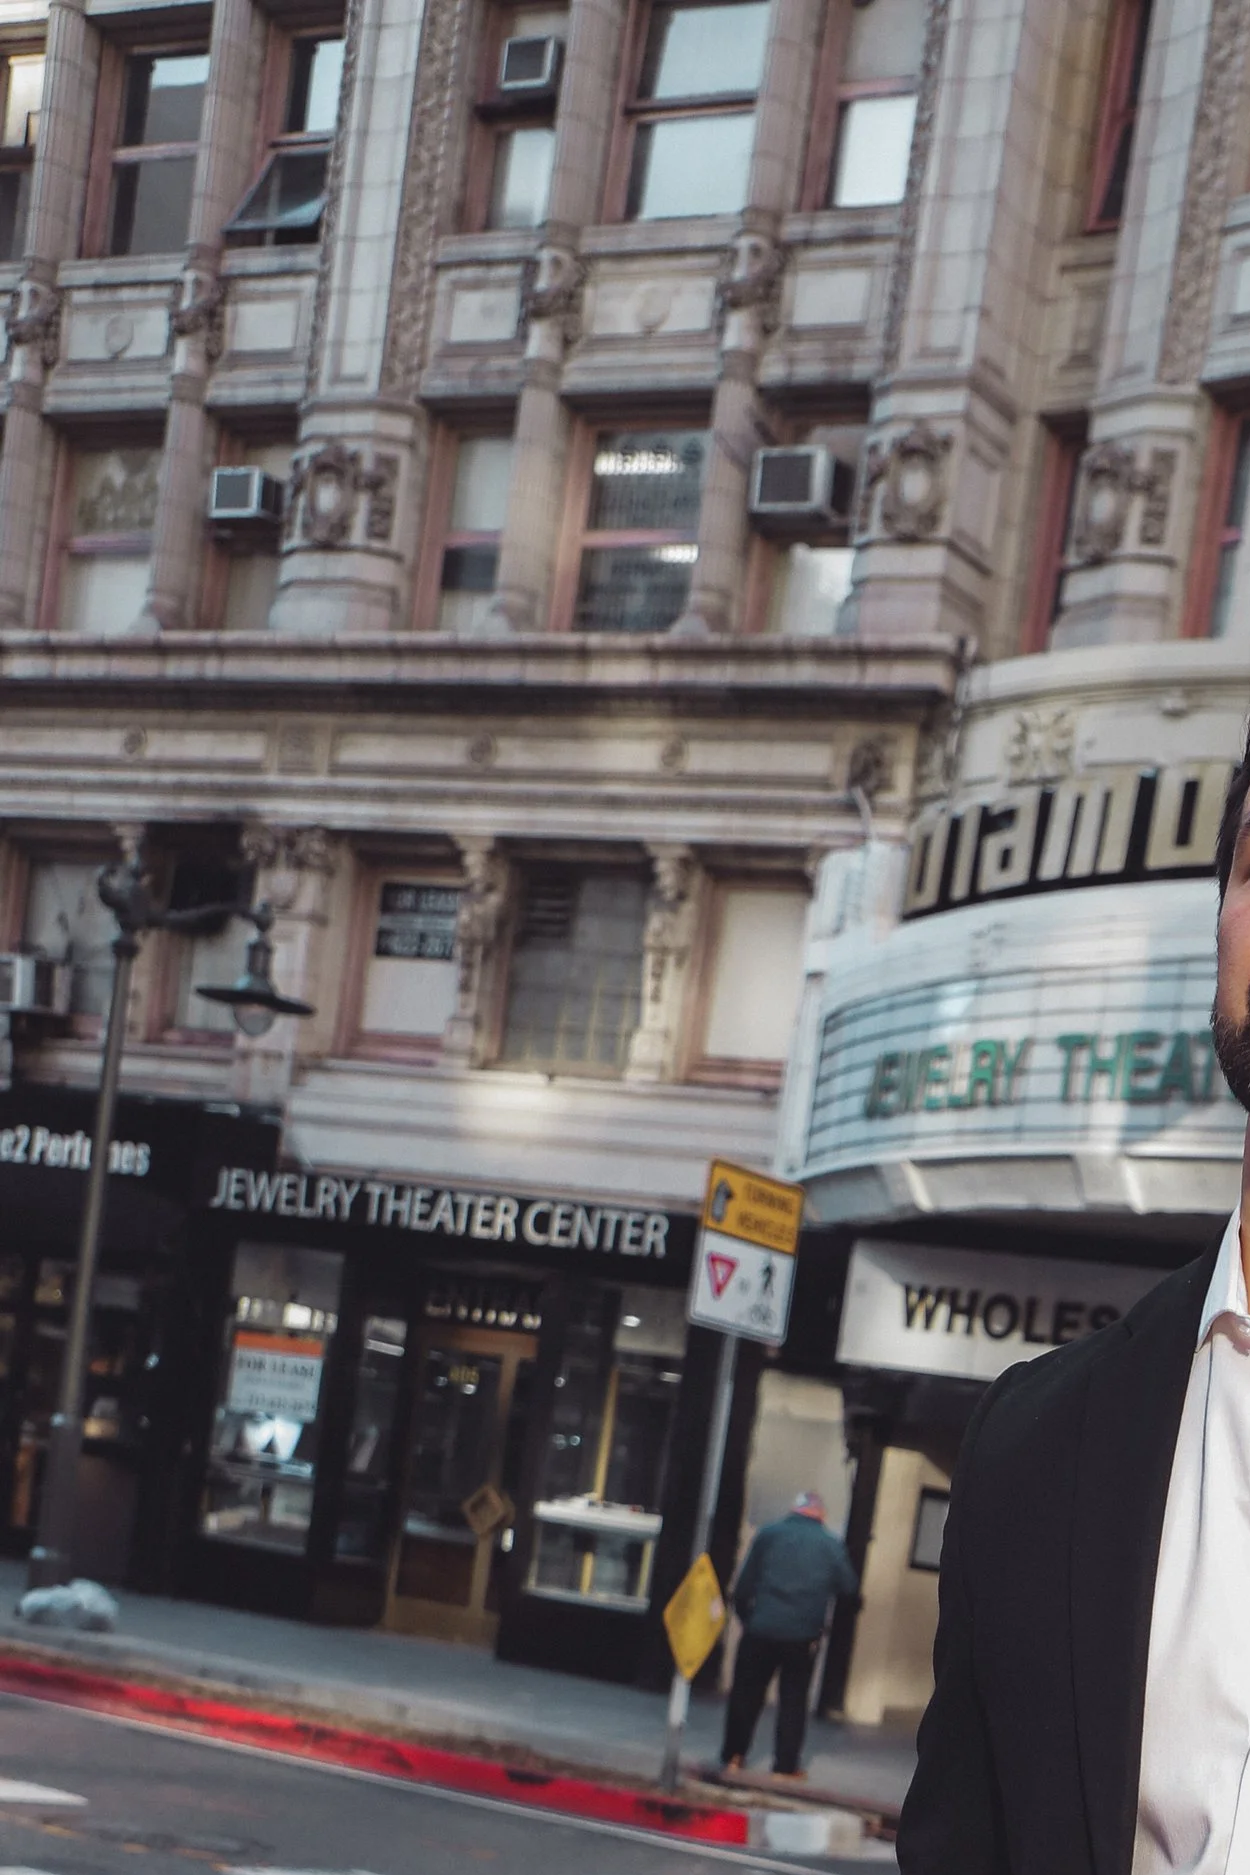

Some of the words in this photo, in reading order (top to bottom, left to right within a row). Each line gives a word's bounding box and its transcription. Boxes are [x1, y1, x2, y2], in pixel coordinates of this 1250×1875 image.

[209, 1166, 361, 1223] JEWELRY
[363, 1181, 518, 1242] THEATER
[522, 1201, 670, 1258] CENTER
